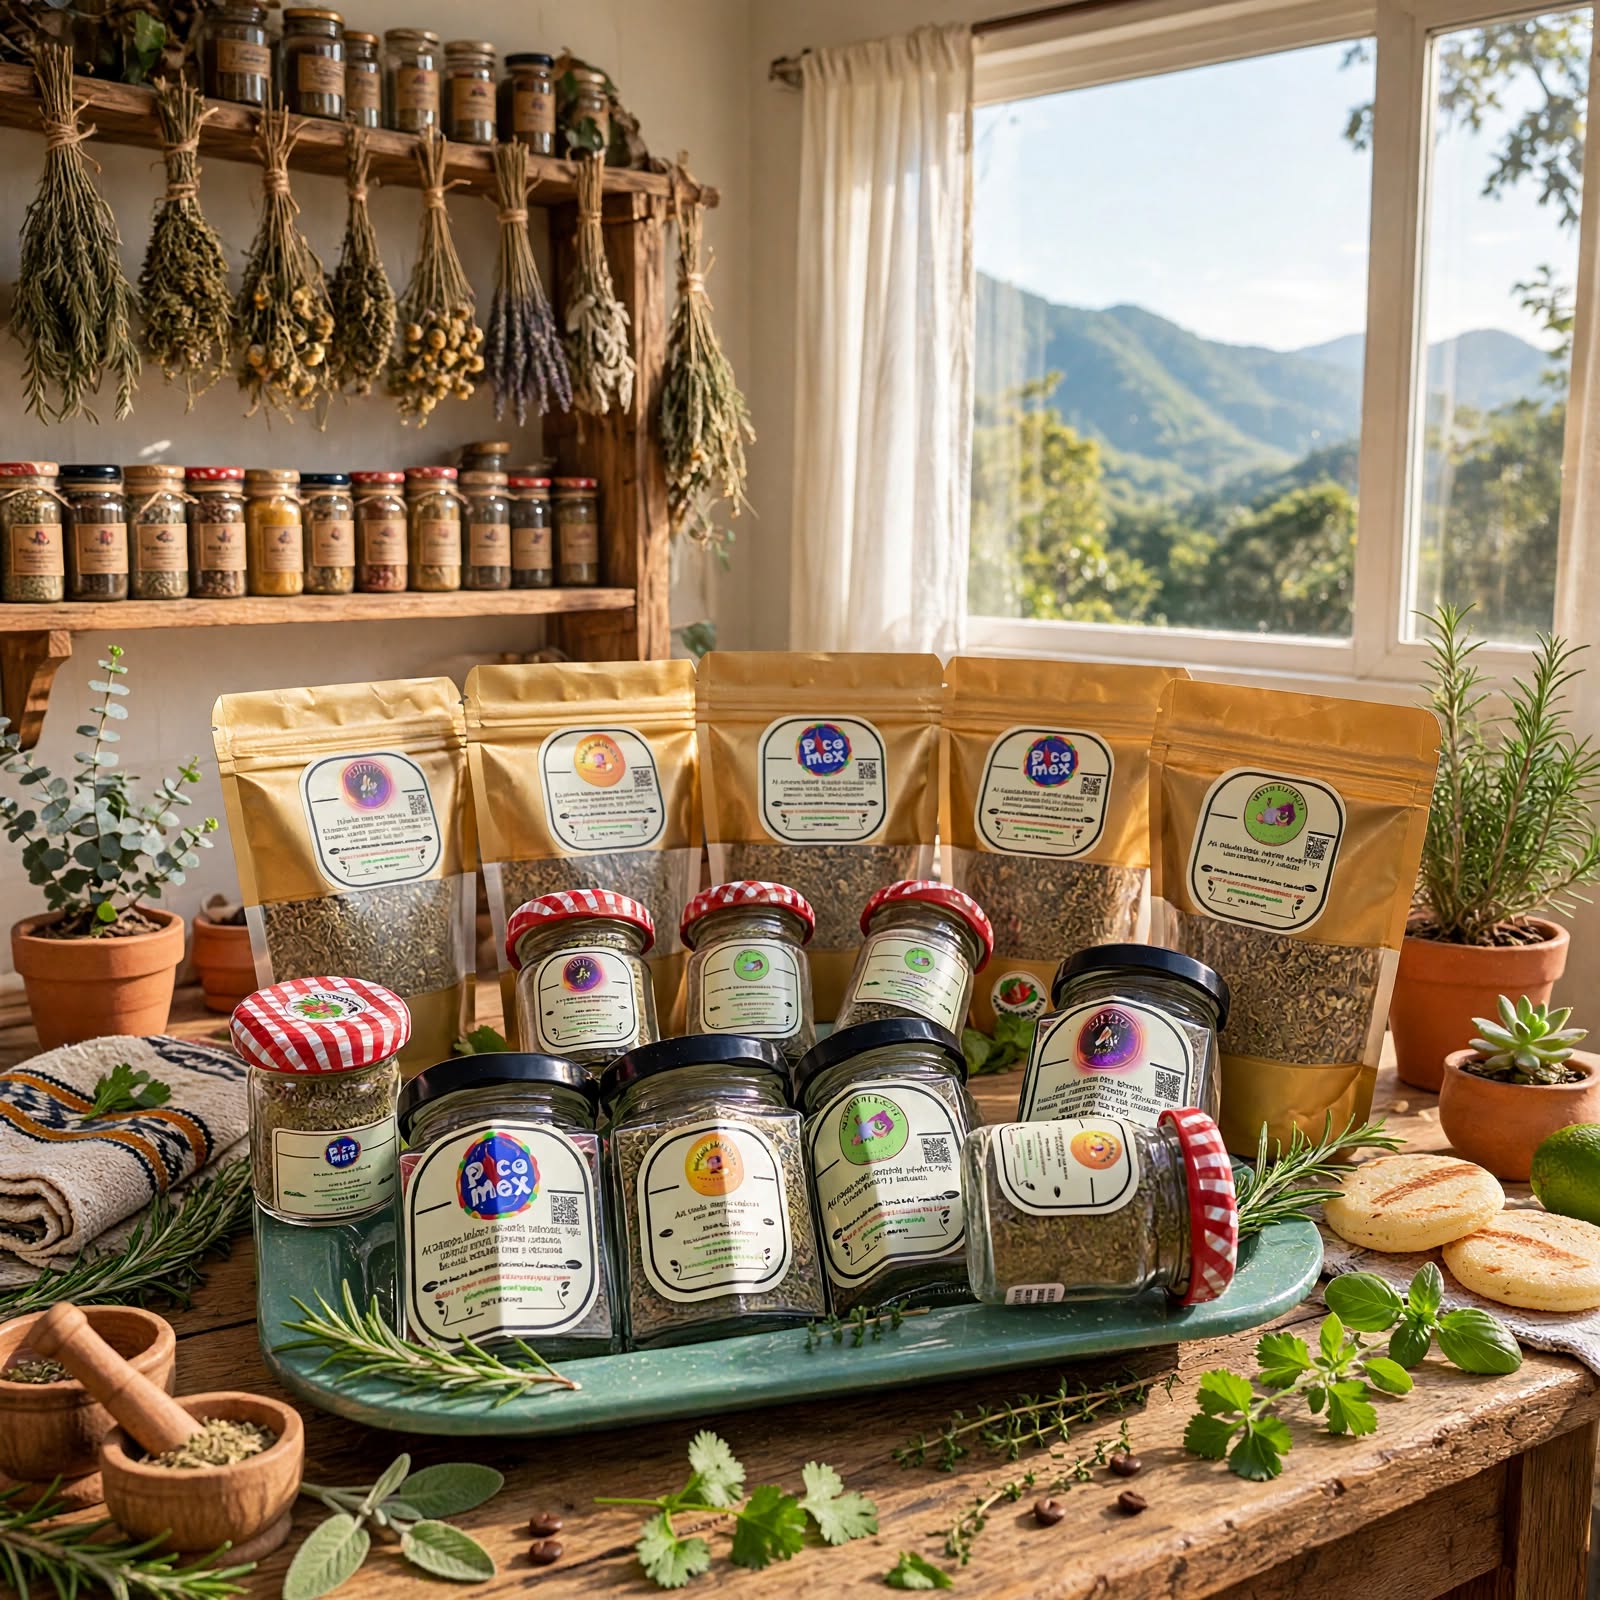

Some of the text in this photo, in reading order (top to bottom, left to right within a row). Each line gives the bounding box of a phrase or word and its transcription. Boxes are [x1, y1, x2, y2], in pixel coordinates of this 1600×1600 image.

[806, 750, 846, 766] mex
[1031, 763, 1070, 777] mex
[470, 1175, 532, 1207] mex
